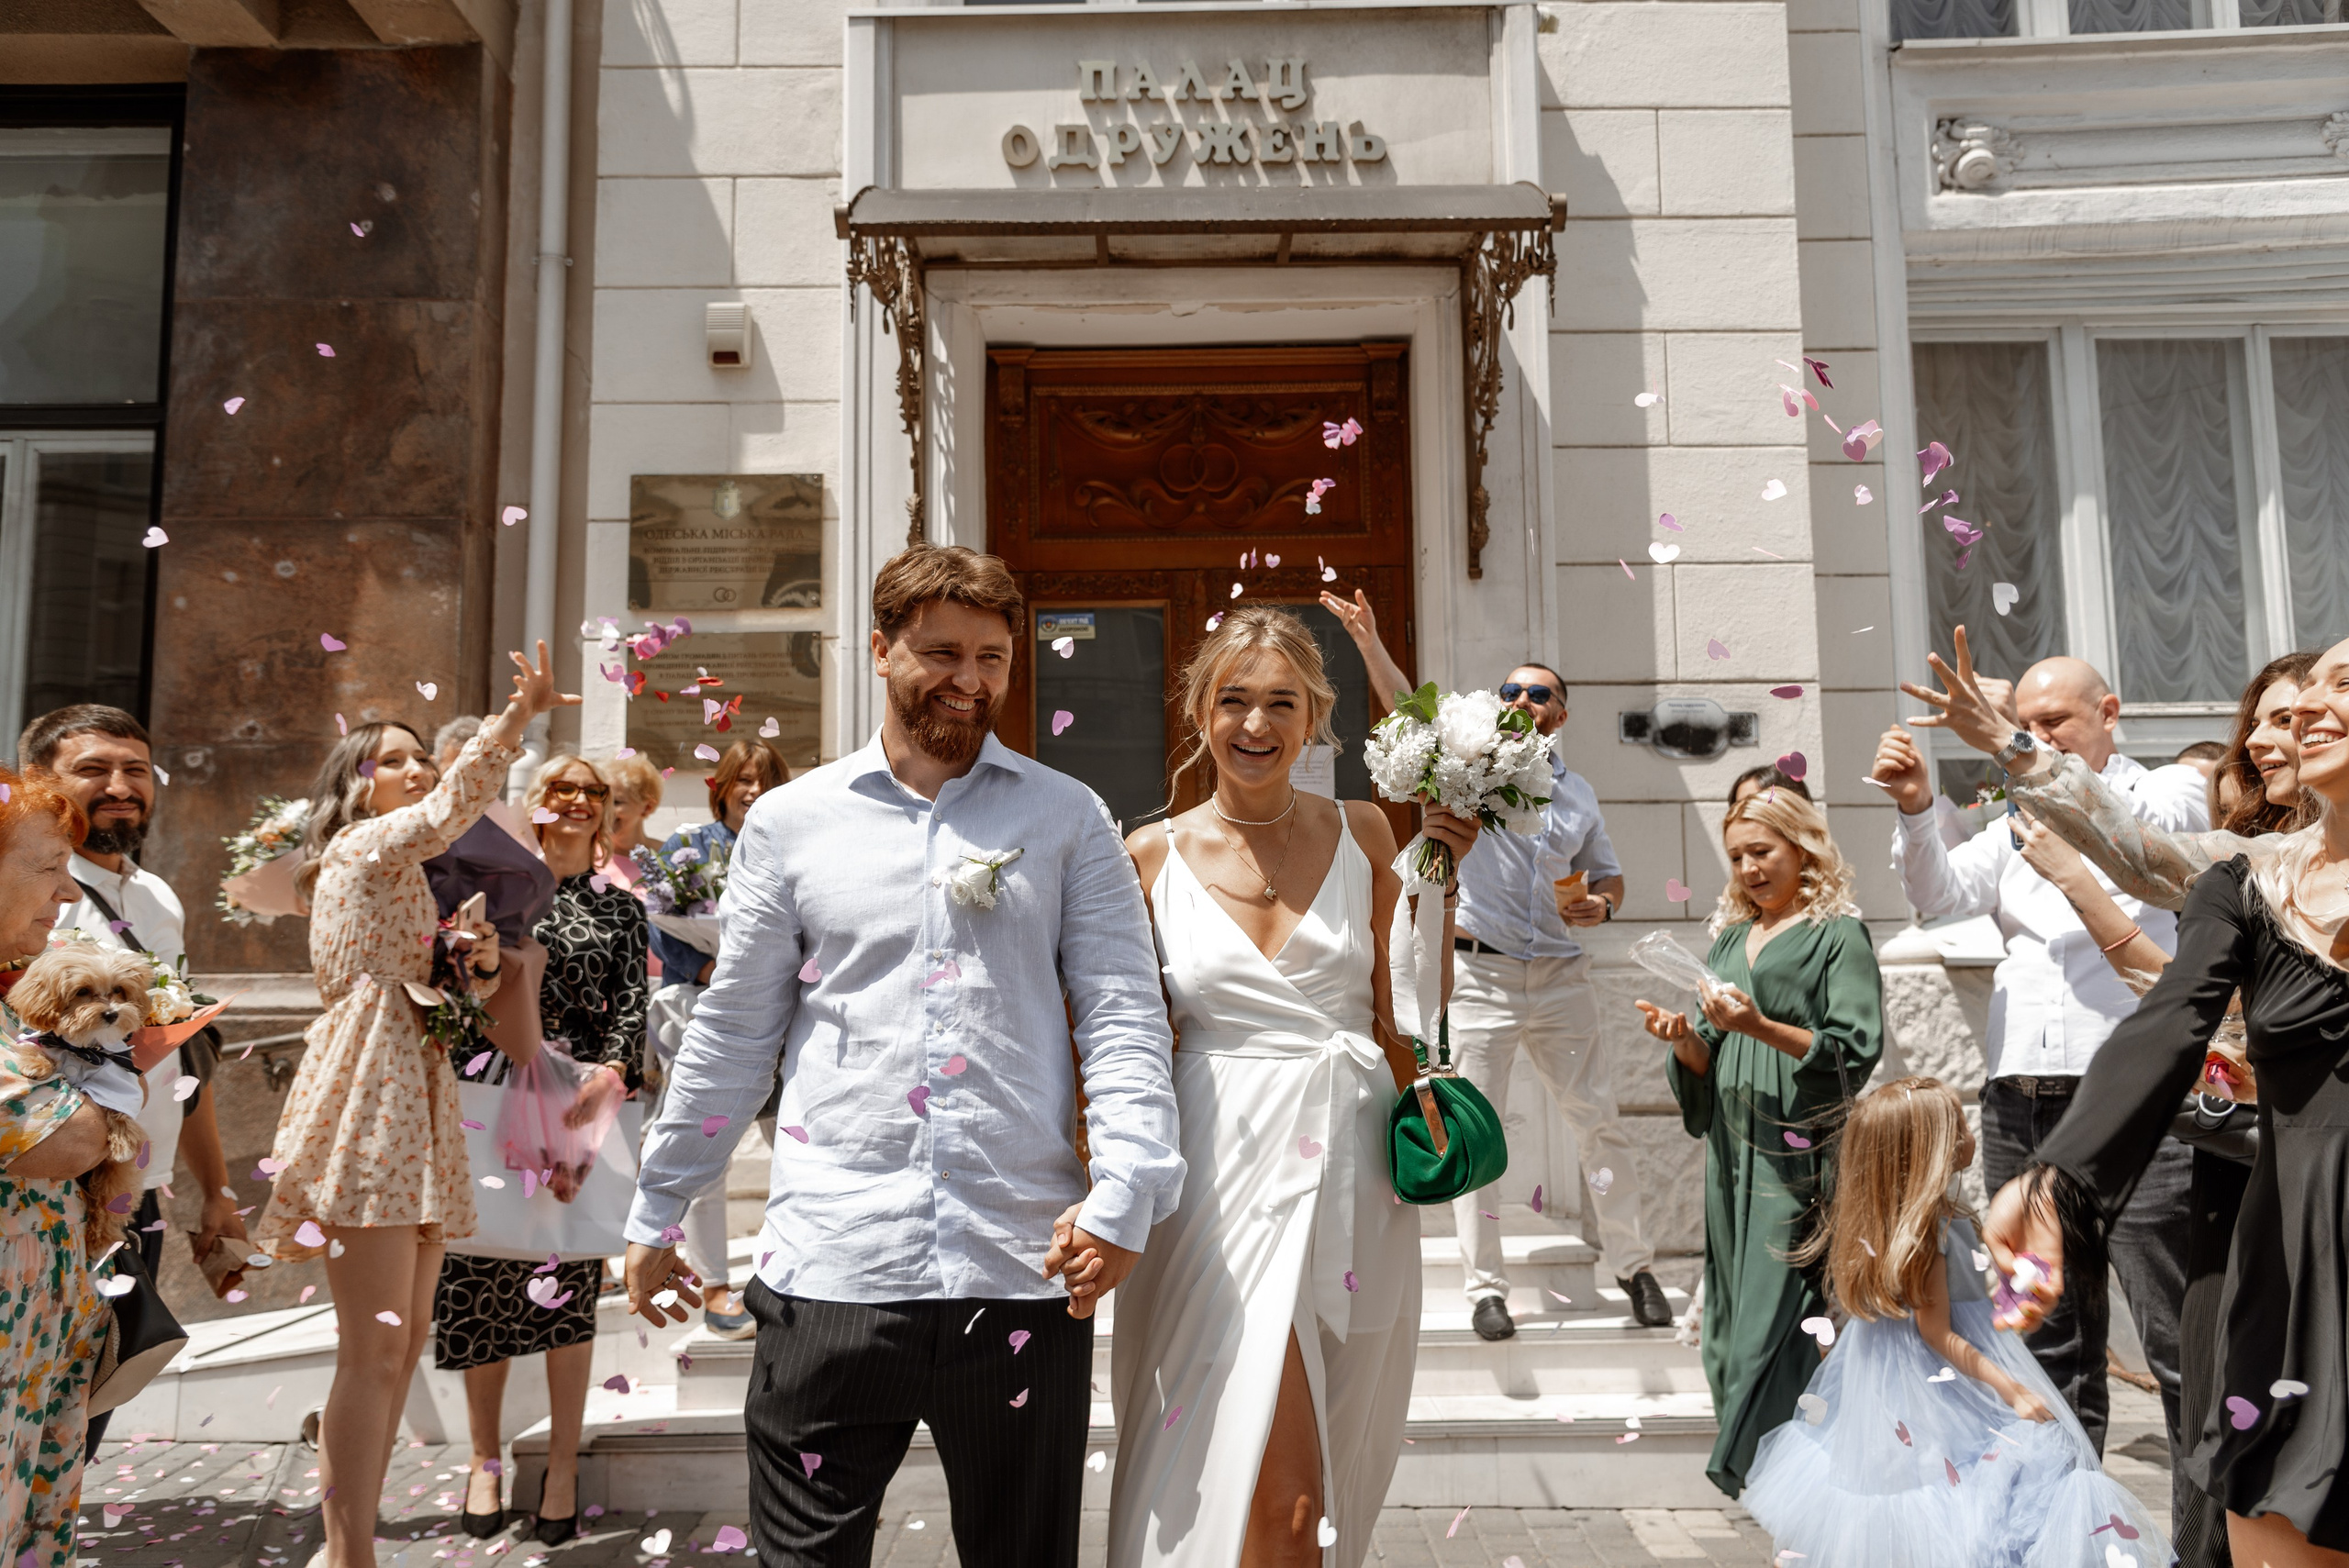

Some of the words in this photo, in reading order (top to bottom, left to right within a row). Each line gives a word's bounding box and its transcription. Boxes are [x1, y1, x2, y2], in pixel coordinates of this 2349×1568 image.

[1078, 58, 1308, 111] ПАЛАЦ
[1001, 120, 1386, 169] ОДРУЖЕНЬ
[644, 528, 707, 540] ОДЕСЬКА
[712, 528, 765, 539] МІСЬКА
[770, 528, 805, 540] РАДА
